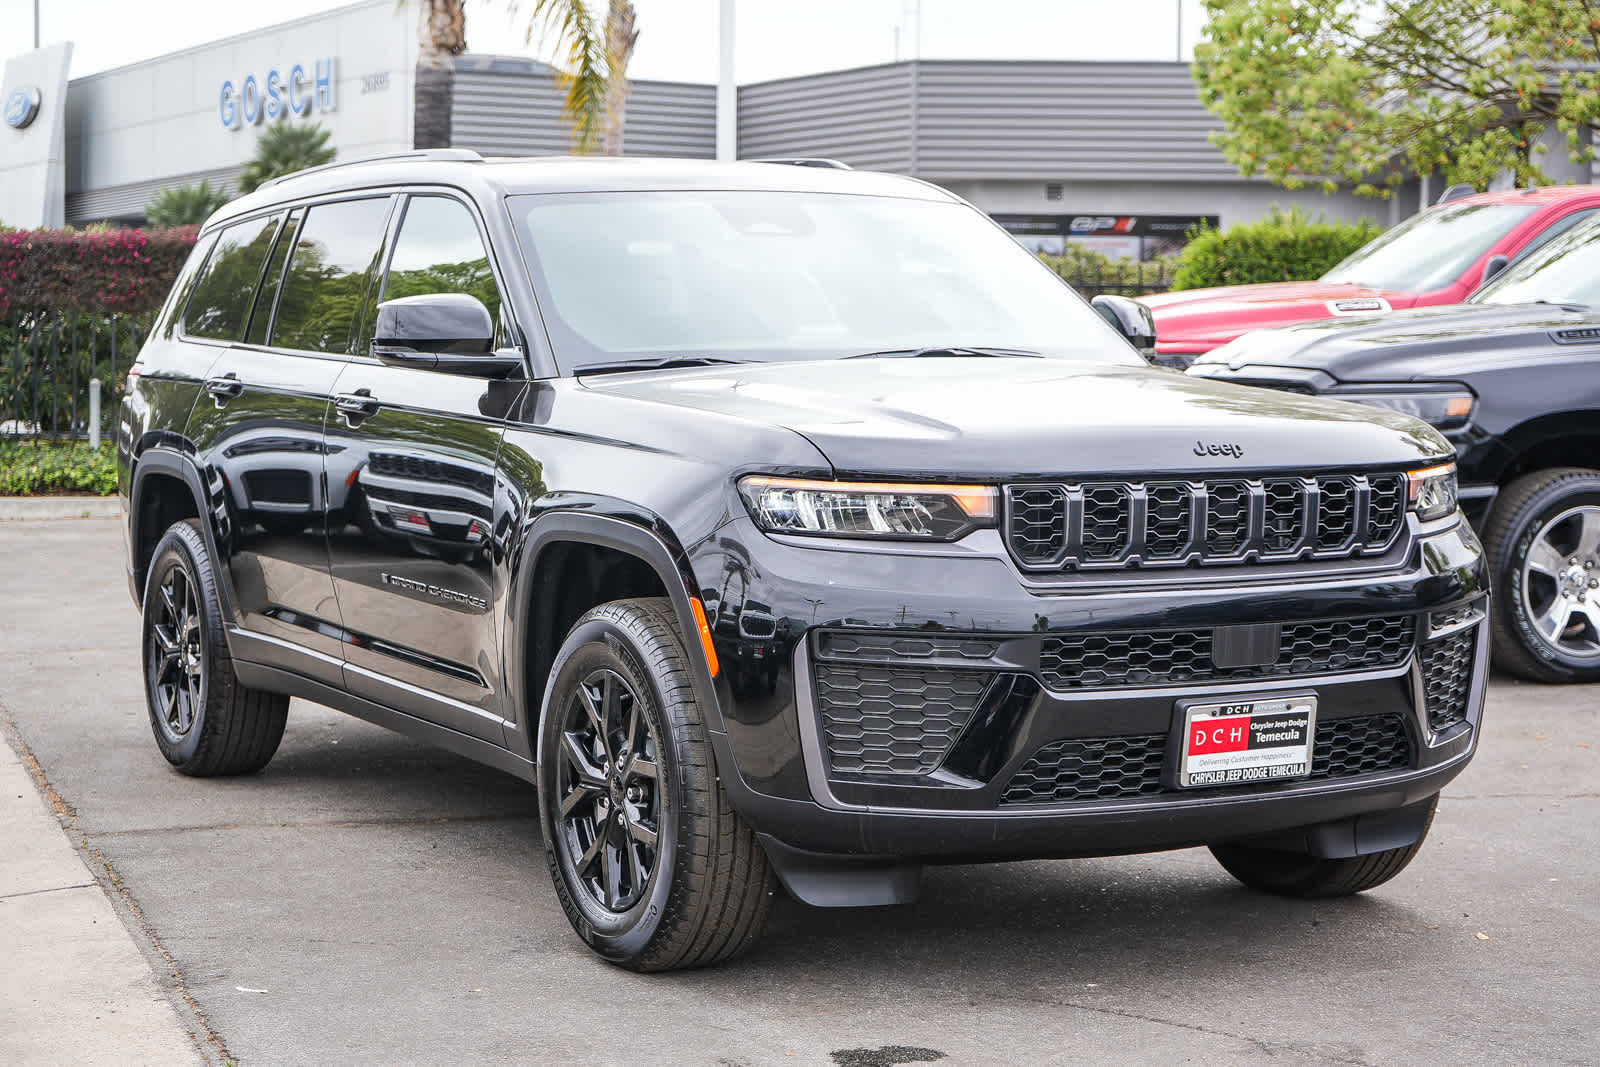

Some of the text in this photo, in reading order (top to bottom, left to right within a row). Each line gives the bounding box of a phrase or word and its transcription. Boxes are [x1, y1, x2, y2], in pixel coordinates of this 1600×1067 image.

[219, 56, 336, 128] GOSCH
[1193, 440, 1244, 459] Jeep
[1250, 718, 1308, 731] Chrysler Jeep Dodge
[1195, 727, 1242, 746] DCH
[1255, 729, 1300, 743] Temecula
[1190, 763, 1305, 785] CHRYSLER JEEP DODGE TEMECULA
